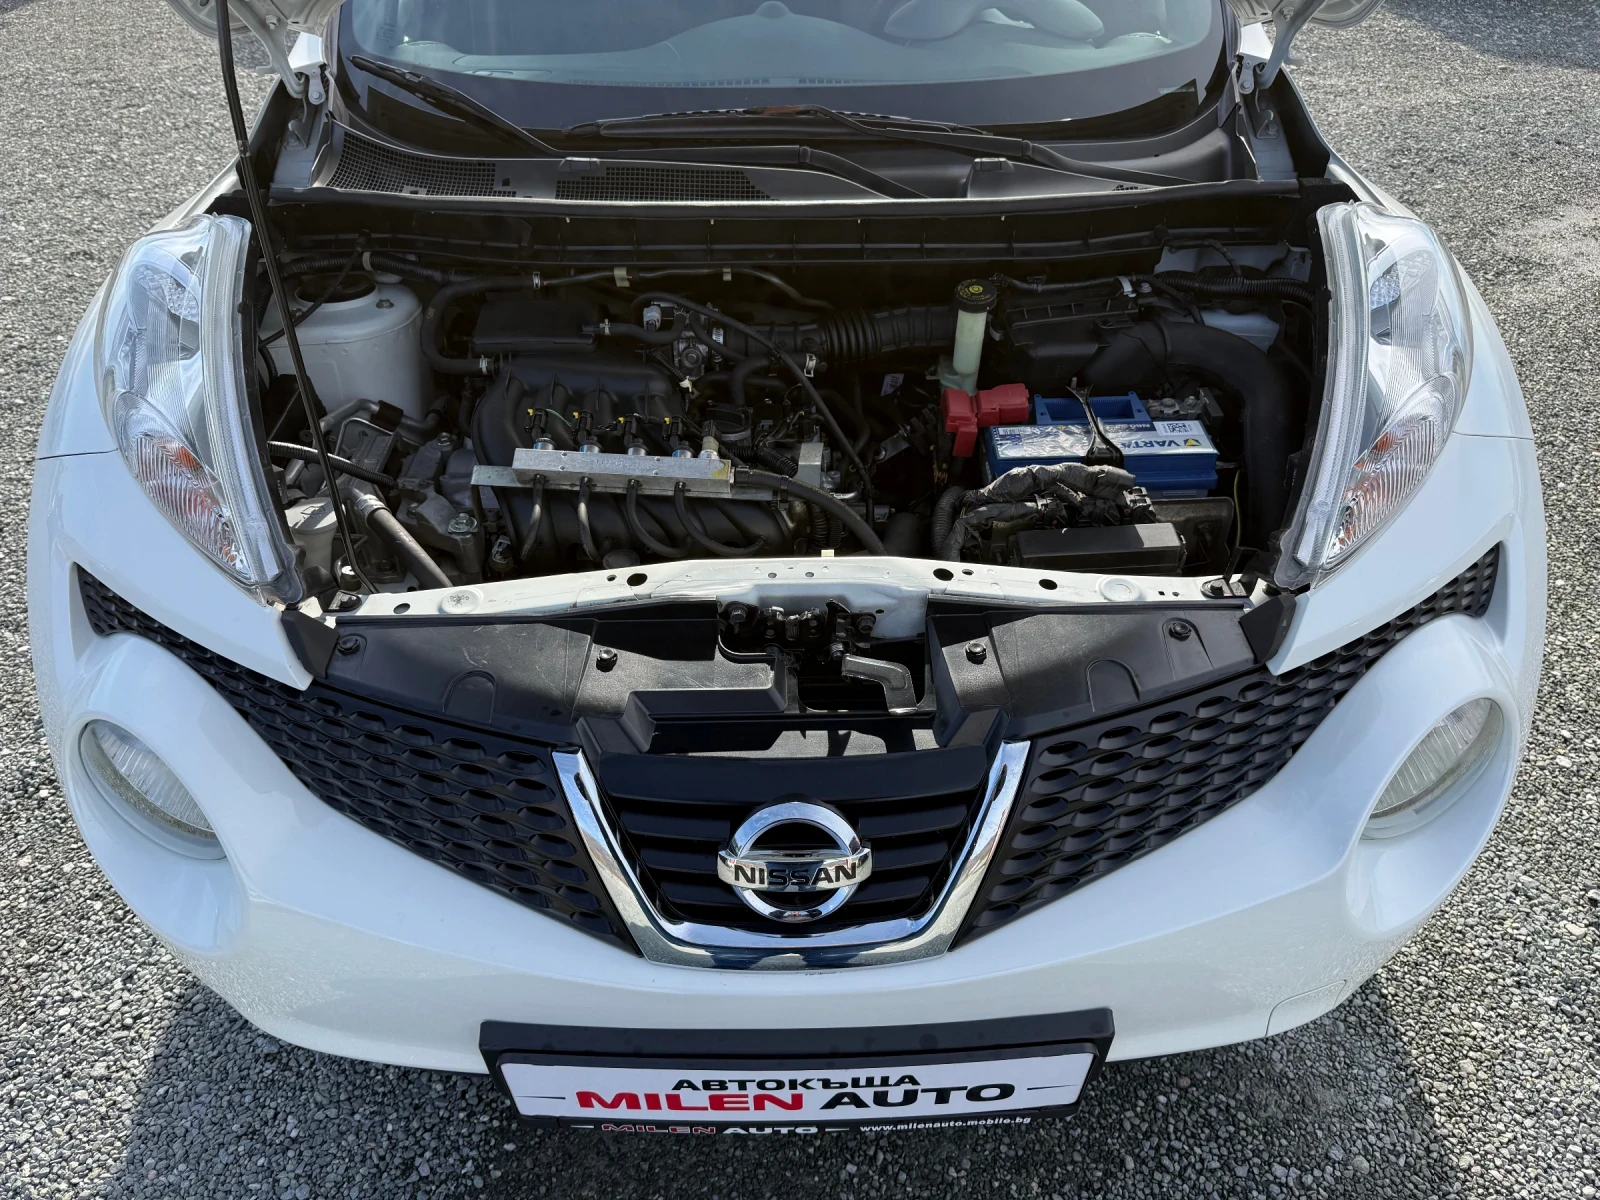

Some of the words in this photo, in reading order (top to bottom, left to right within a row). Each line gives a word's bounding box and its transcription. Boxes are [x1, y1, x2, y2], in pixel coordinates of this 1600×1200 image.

[734, 863, 857, 885] NISSAN
[576, 1091, 804, 1111] MILEN
[819, 1083, 1016, 1109] AUTO
[601, 1124, 716, 1135] MILEN
[722, 1126, 819, 1135] AUTO
[859, 1116, 1032, 1132] www.milenauto.mobile.bg
